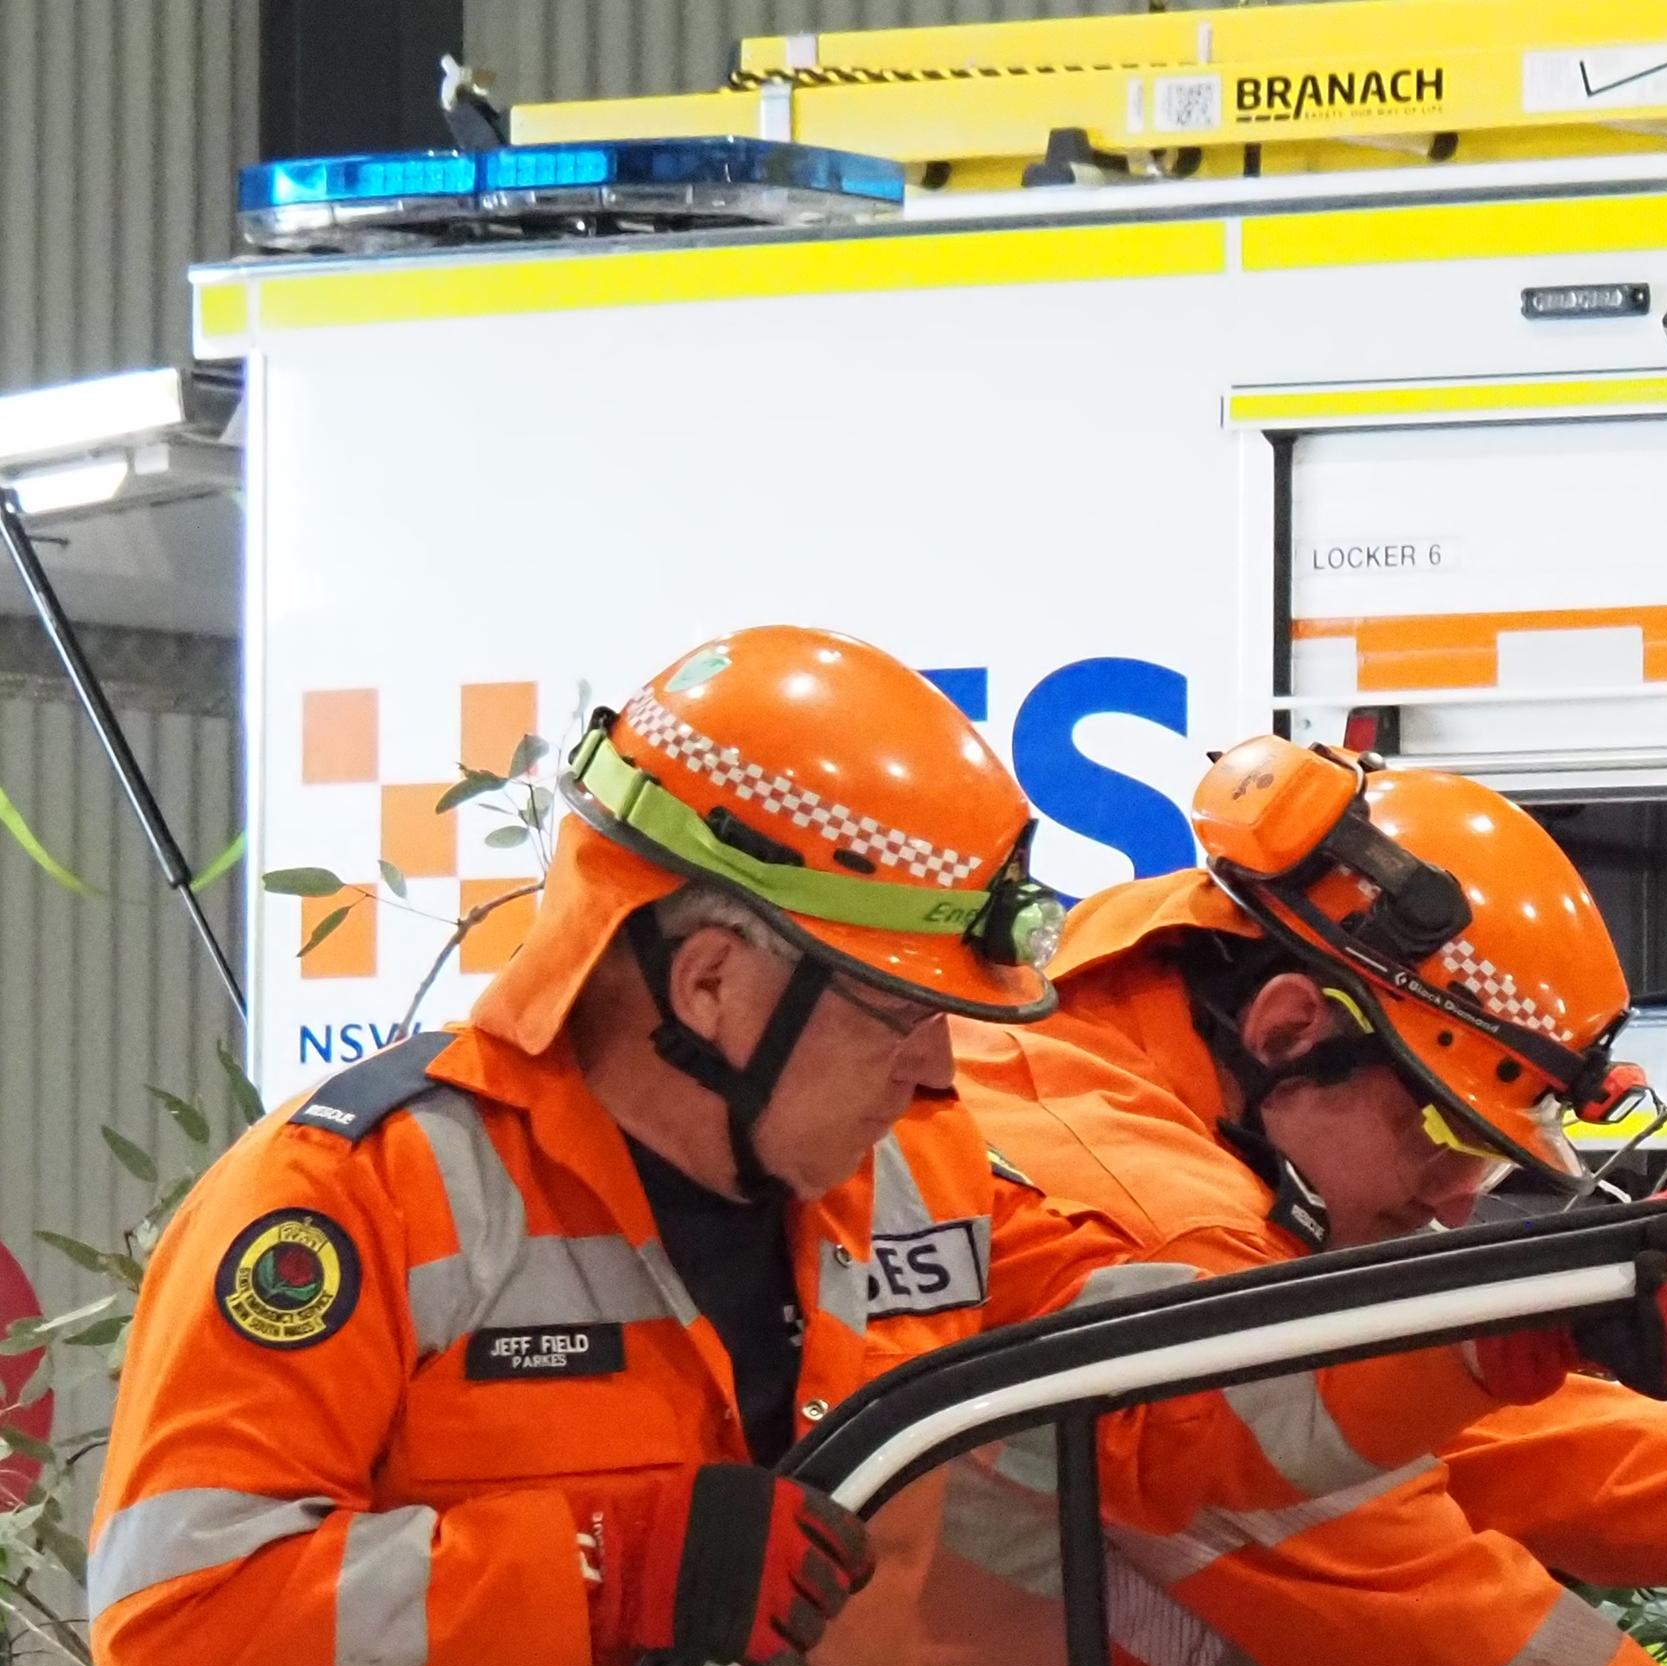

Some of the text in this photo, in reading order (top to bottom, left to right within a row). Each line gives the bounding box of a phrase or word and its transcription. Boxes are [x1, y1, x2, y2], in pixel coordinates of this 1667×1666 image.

[1236, 68, 1443, 119] BRANACH
[1312, 543, 1442, 570] LOCKER 6
[1407, 980, 1500, 1034] Black Diamond
[490, 1334, 590, 1356] JEFF FIELD
[511, 1353, 568, 1368] PARKES
